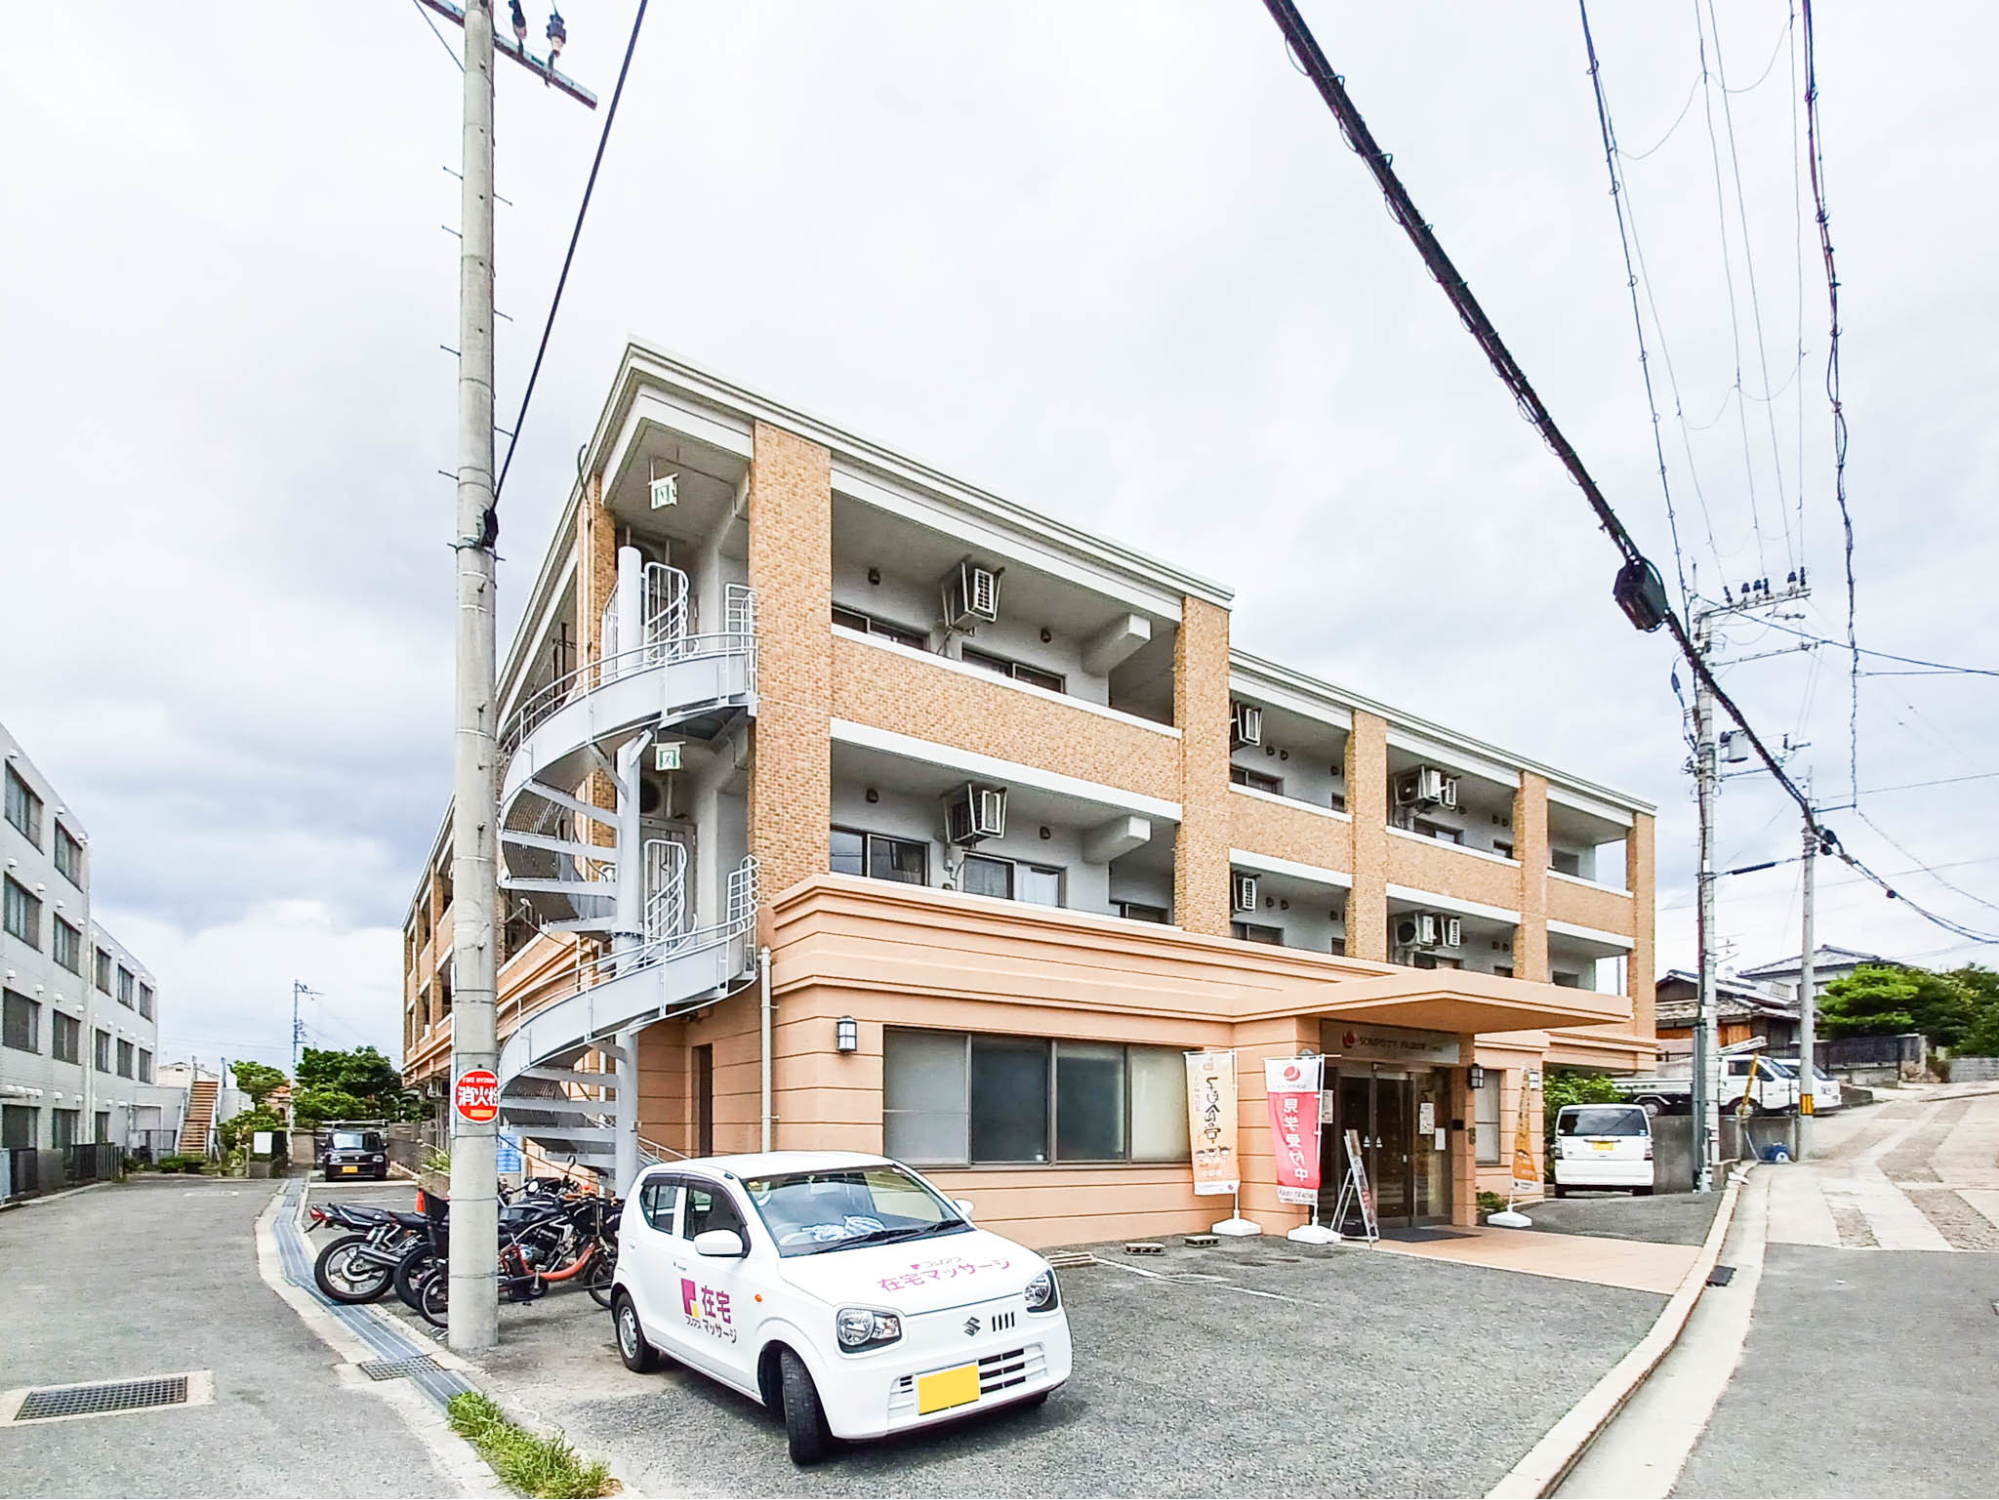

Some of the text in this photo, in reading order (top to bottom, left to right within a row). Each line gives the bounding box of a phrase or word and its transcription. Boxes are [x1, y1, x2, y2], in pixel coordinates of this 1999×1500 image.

[877, 1258, 1010, 1293] 在宅マッサージ
[701, 1285, 732, 1325] 在宅
